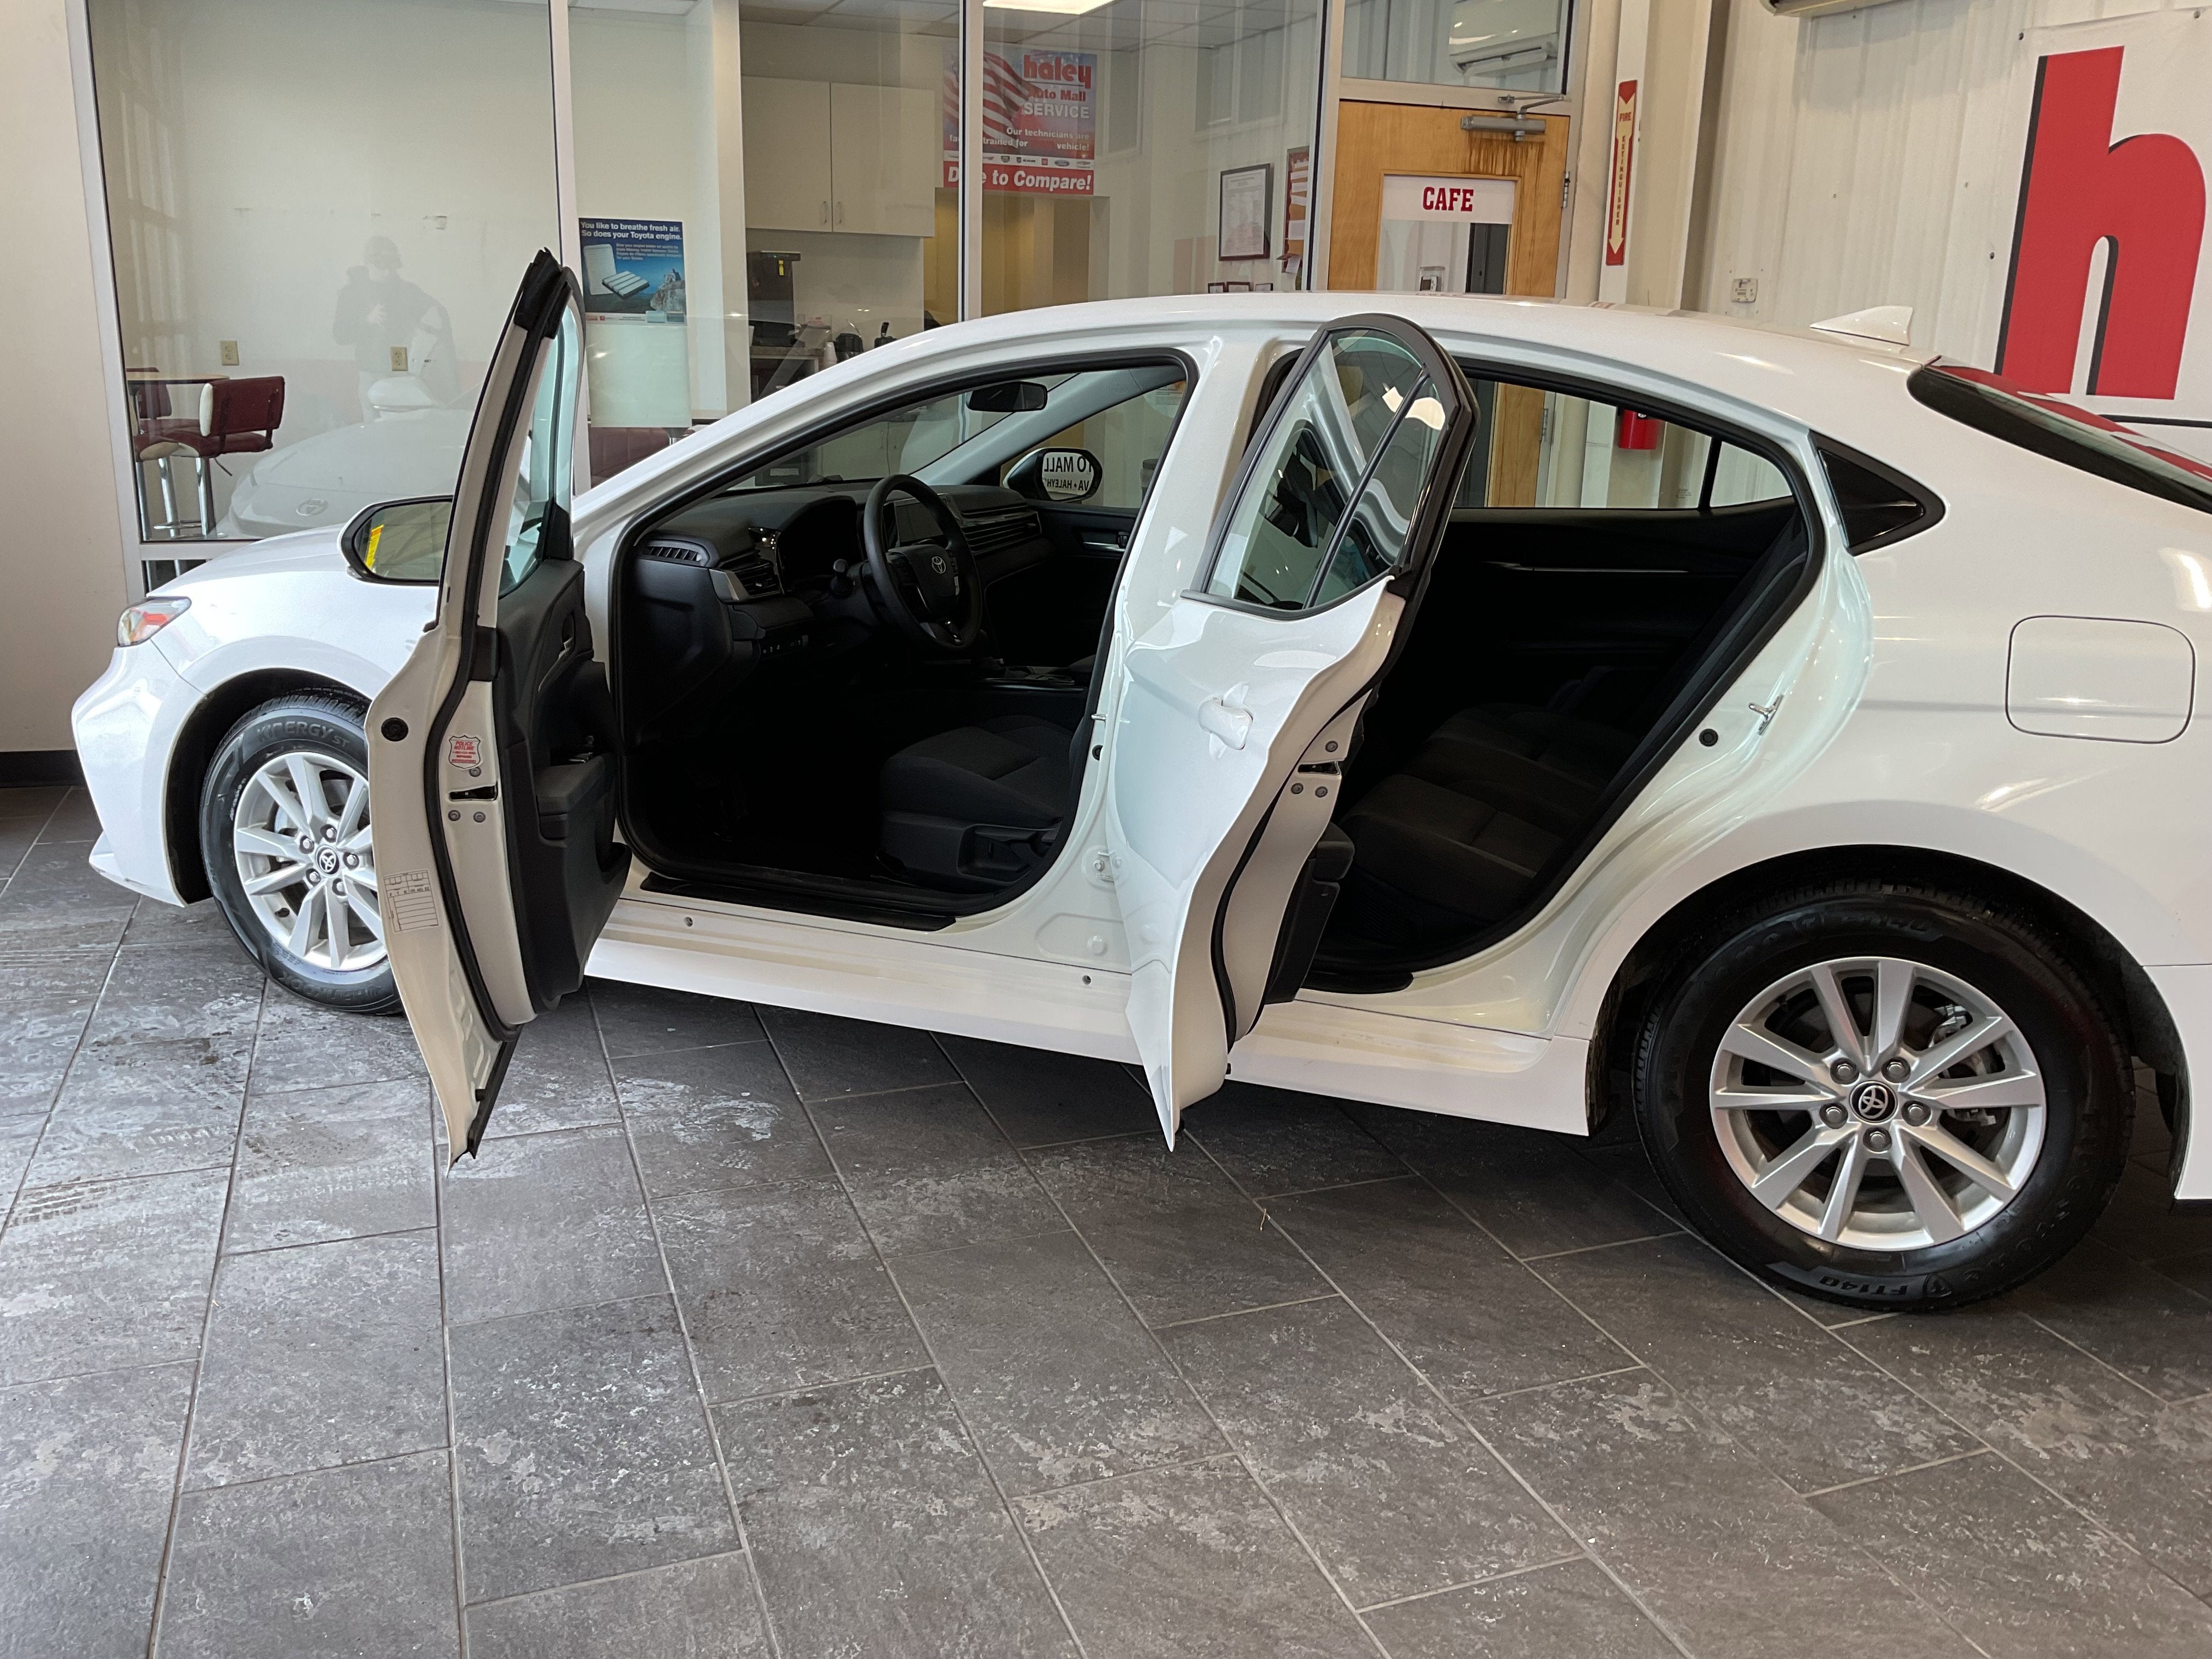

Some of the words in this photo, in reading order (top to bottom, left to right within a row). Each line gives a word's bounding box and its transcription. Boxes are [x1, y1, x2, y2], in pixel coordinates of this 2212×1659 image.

[1024, 55, 1092, 89] haley
[1029, 89, 1056, 99] Auto
[1060, 90, 1086, 101] Mall
[1024, 101, 1090, 119] SERVICE
[1619, 111, 1632, 123] FIRE
[1006, 127, 1022, 136] Our
[1025, 128, 1074, 139] technicians
[983, 138, 1013, 146] trained
[1015, 138, 1028, 148] for
[1056, 142, 1090, 151] vehicle!
[948, 166, 986, 184] De
[992, 170, 1009, 185] to
[1014, 171, 1092, 191] Compare!
[1616, 136, 1626, 226] EXTINGUISHER
[1422, 186, 1474, 212] CAFE
[630, 232, 654, 240] Toyota
[256, 721, 334, 743] KINERGY
[331, 735, 351, 748] ST
[1819, 1276, 1909, 1296] FT140
